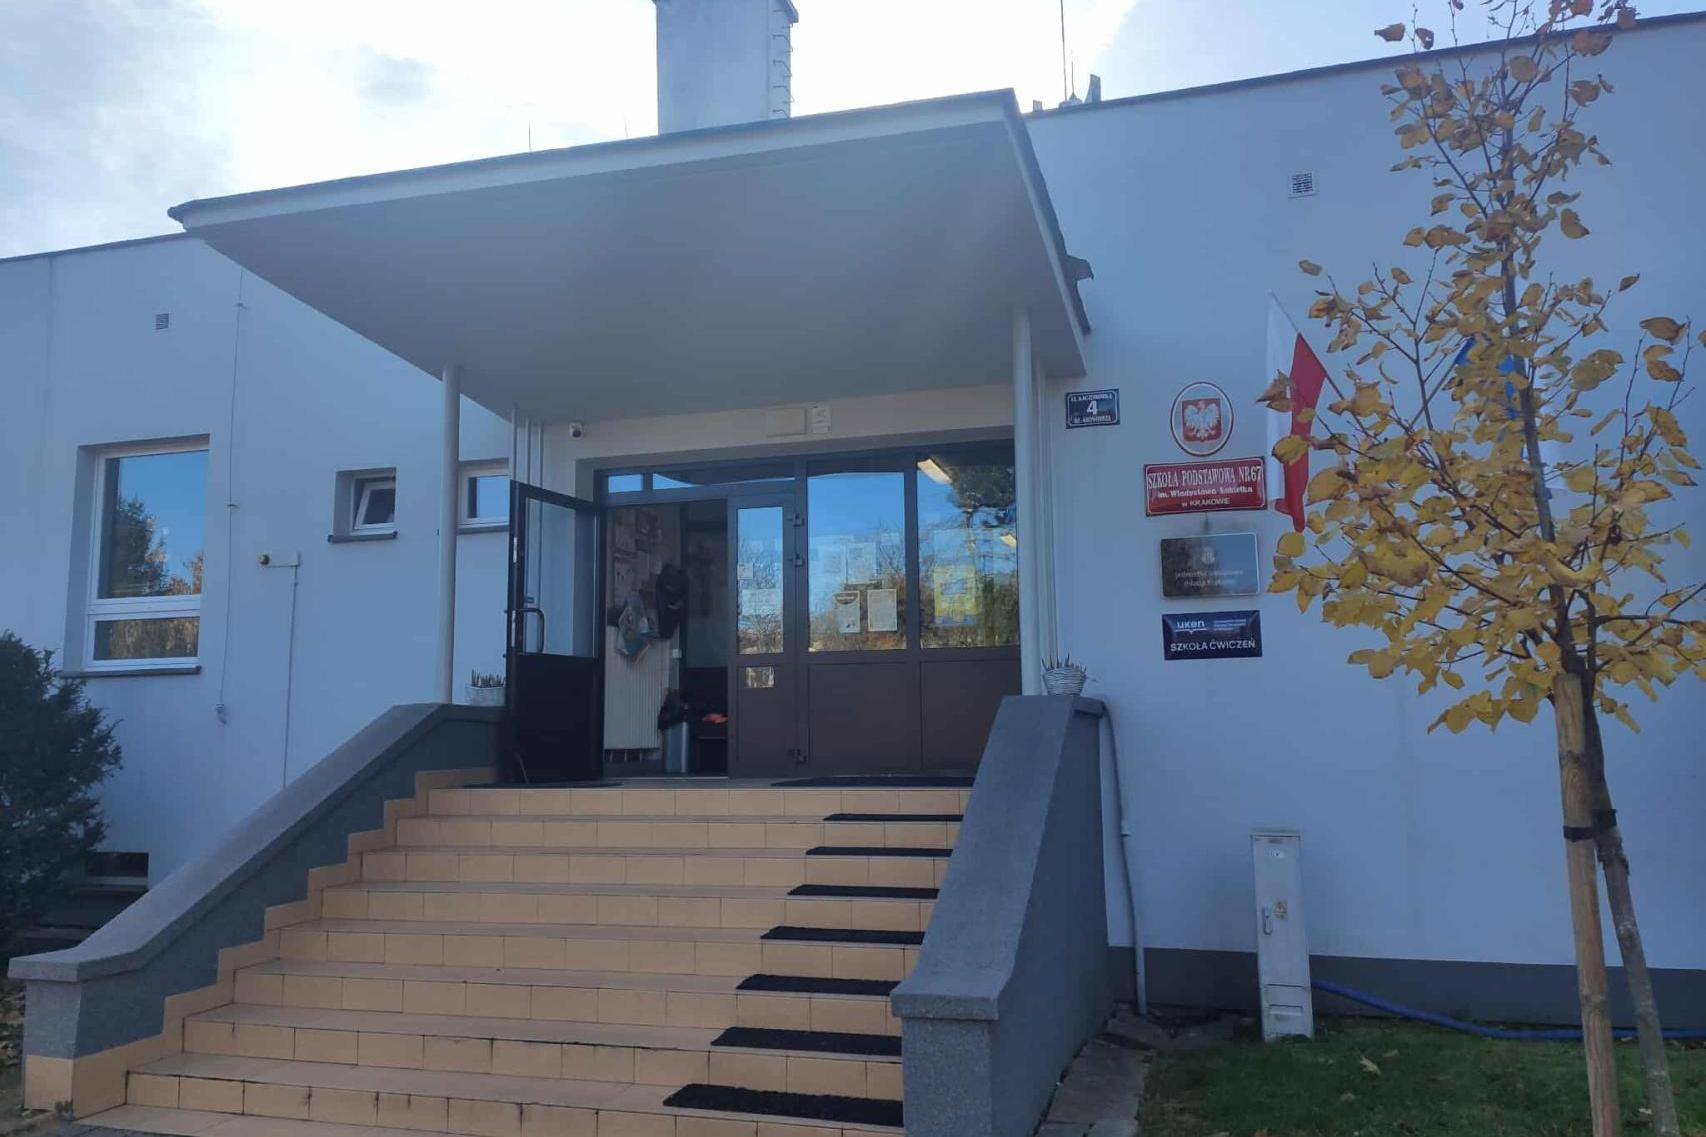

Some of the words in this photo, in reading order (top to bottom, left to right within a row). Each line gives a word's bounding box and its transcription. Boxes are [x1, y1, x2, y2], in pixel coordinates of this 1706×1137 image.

[1087, 400, 1098, 415] 4
[1147, 472, 1179, 489] SZKOŁA
[1182, 468, 1236, 486] PODSTAWOWA
[1189, 498, 1231, 507] KRAKOWIE
[1170, 642, 1208, 652] SZKOŁA
[1209, 638, 1256, 651] ĆWICZEŃ
